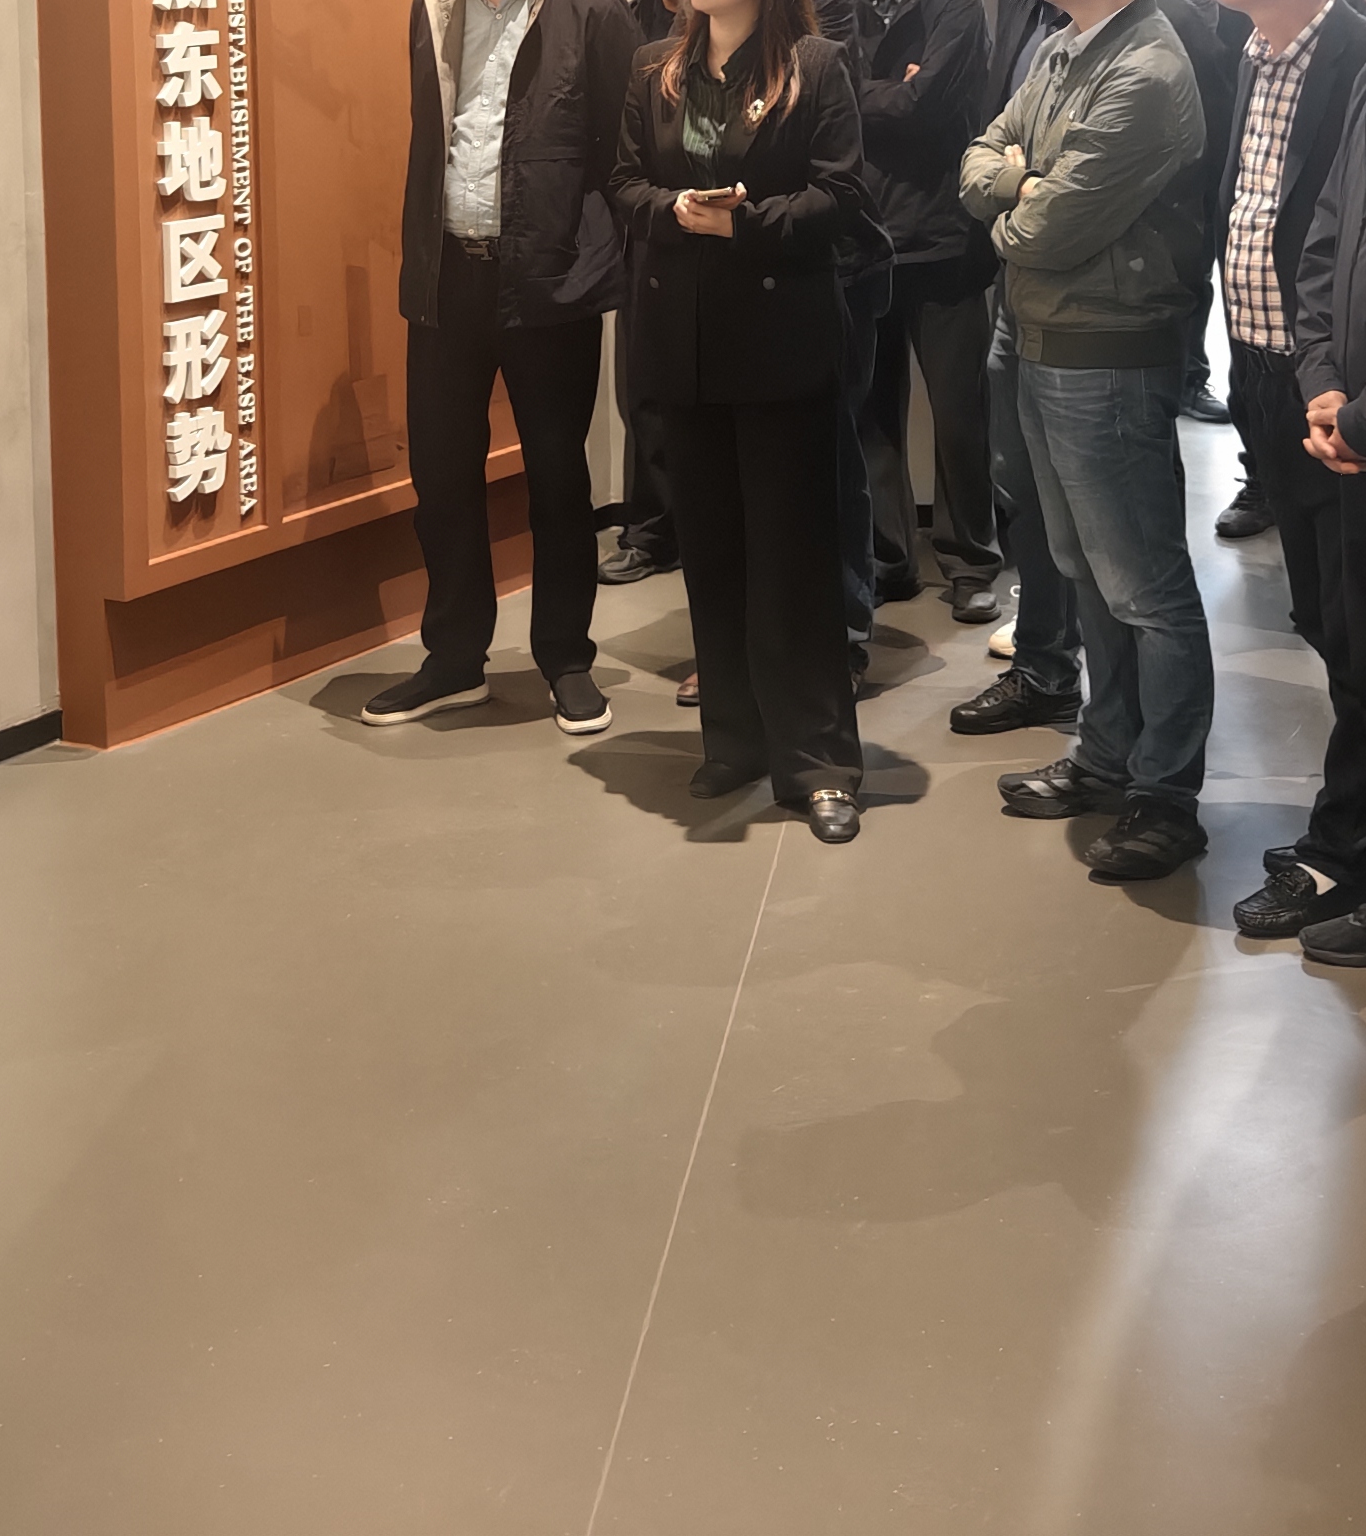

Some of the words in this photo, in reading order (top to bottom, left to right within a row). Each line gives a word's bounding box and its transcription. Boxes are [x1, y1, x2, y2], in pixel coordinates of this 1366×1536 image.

[234, 237, 253, 273] OF
[236, 285, 255, 343] THE
[237, 353, 256, 425] BASE
[238, 438, 259, 516] AREA
